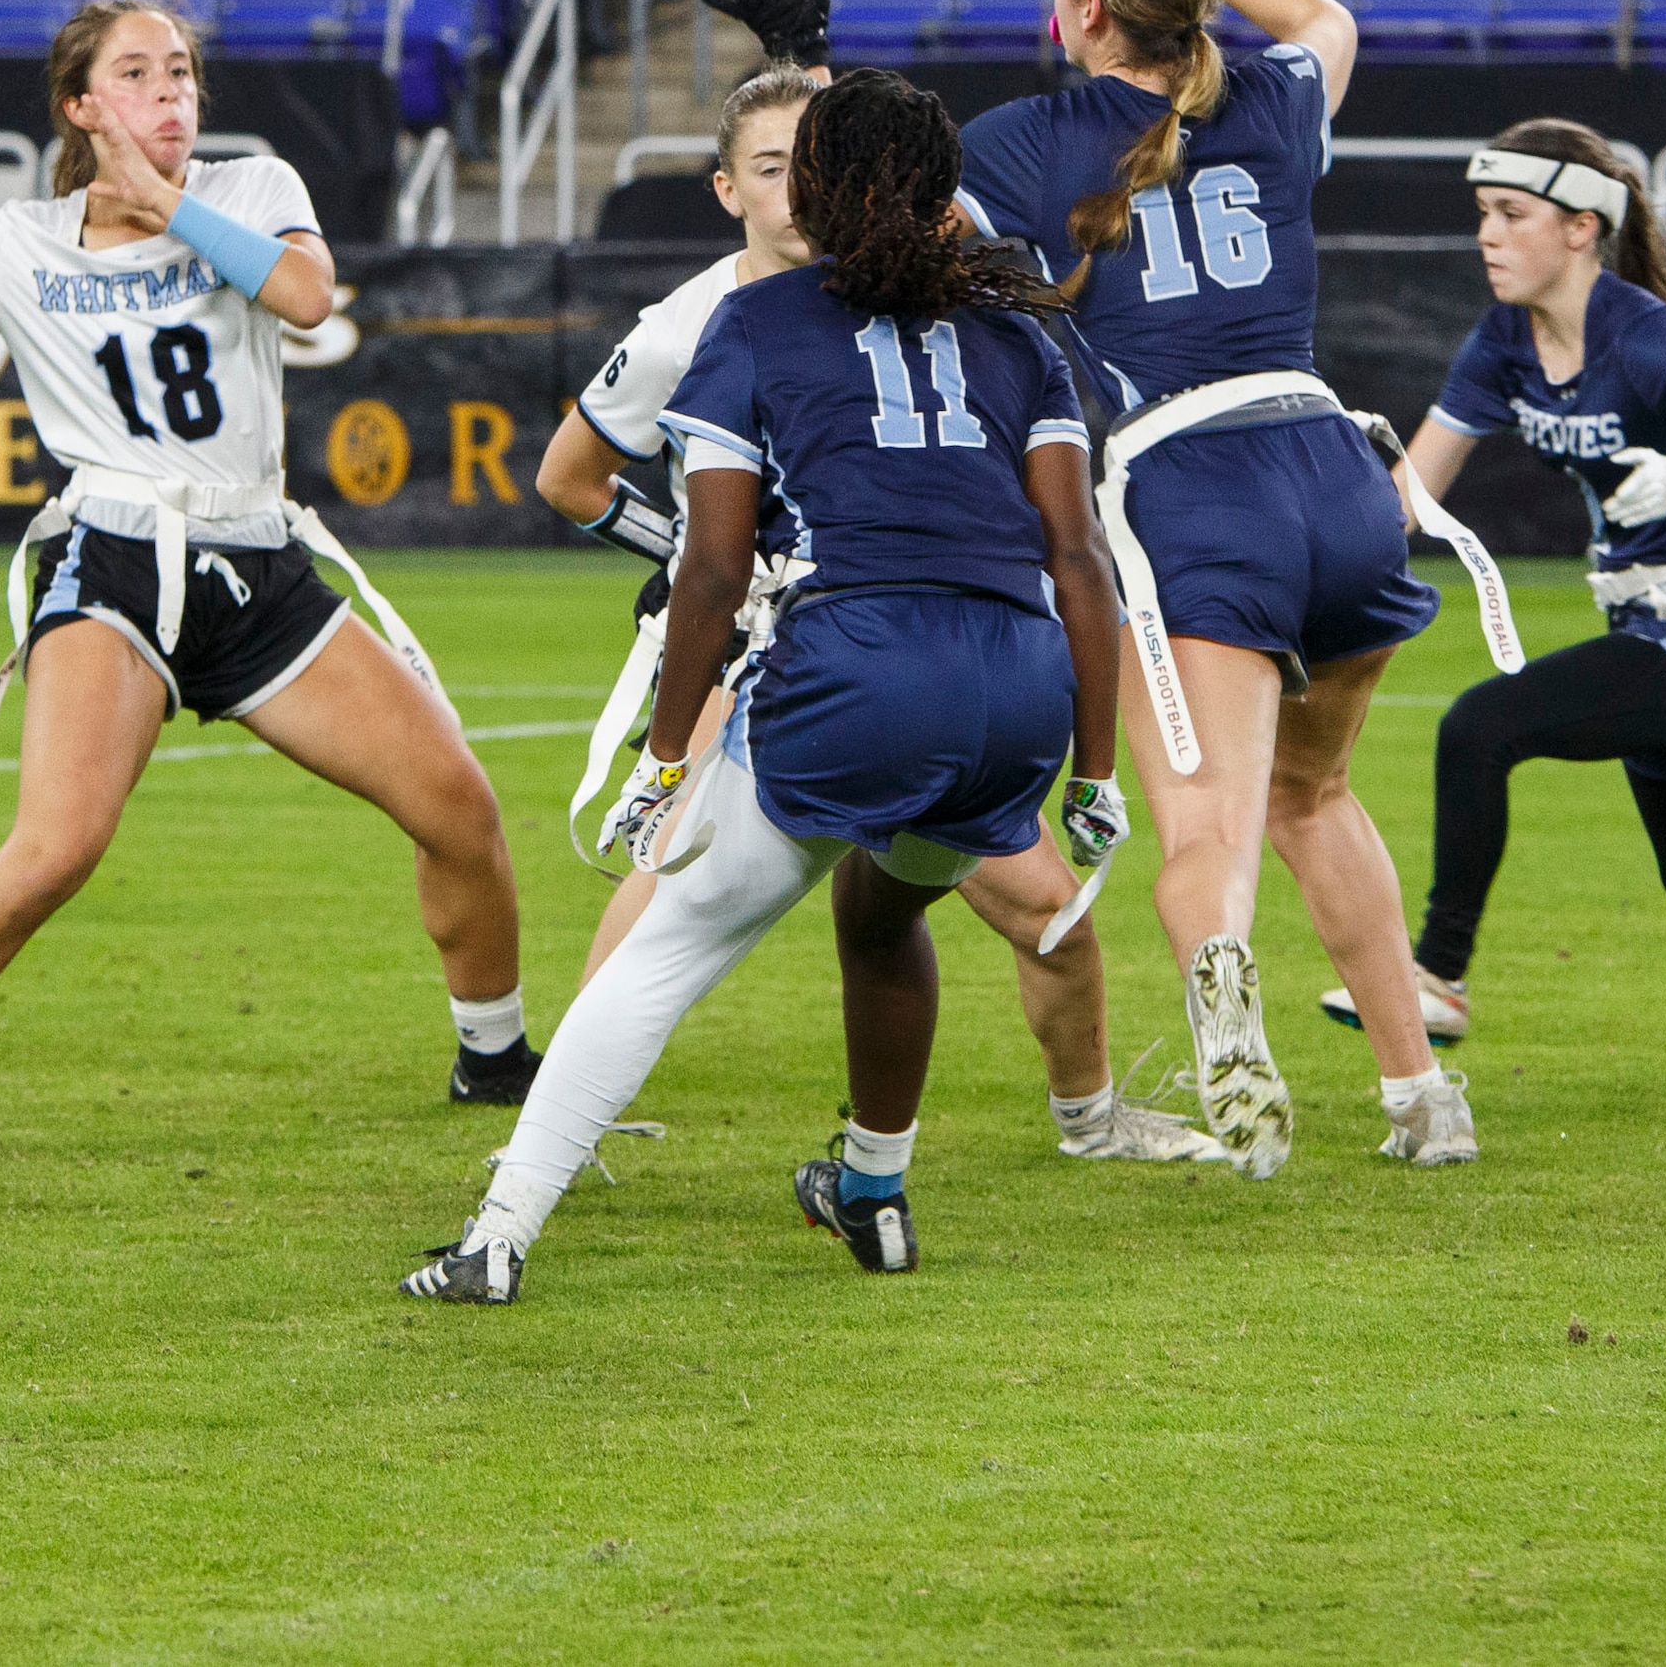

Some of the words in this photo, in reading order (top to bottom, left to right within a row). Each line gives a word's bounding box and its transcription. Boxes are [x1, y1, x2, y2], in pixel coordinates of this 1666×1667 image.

[32, 257, 228, 314] WHITMA
[1129, 163, 1273, 303] 16
[94, 320, 224, 444] 18
[853, 314, 988, 449] 11
